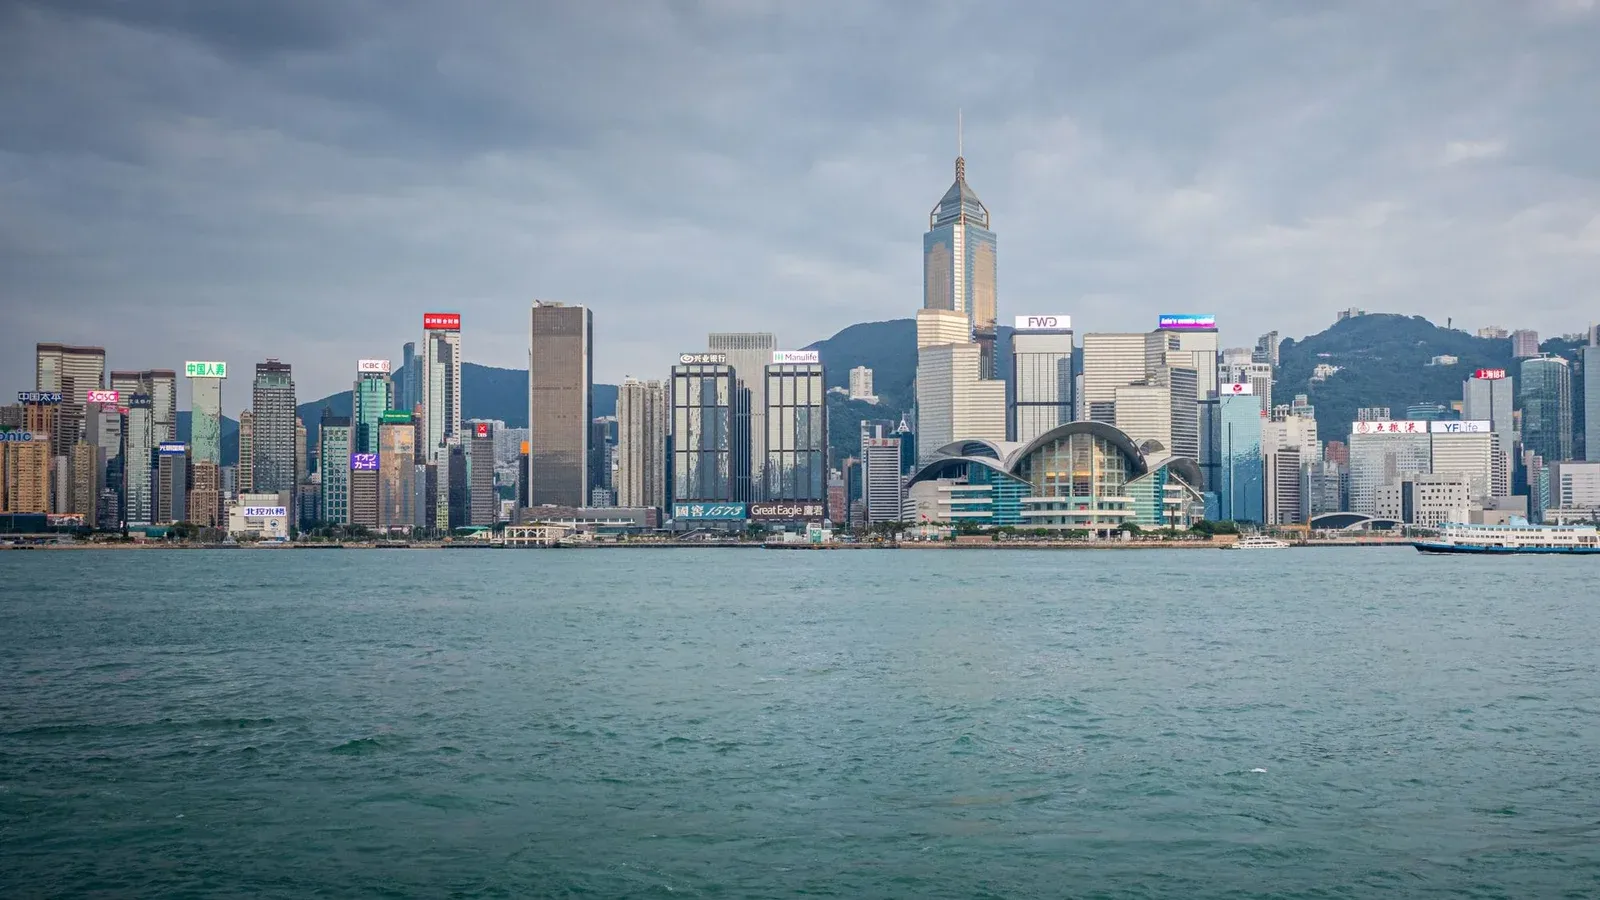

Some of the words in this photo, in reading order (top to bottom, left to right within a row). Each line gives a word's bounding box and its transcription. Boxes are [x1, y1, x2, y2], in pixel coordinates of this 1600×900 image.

[1028, 317, 1057, 327] FWD
[785, 353, 817, 361] Manulife
[187, 363, 225, 375] 中国人寿
[18, 392, 62, 401] 中国太平
[354, 454, 377, 462] イオン
[354, 461, 377, 469] カード
[751, 504, 777, 516] Great
[777, 504, 803, 518] Eagle
